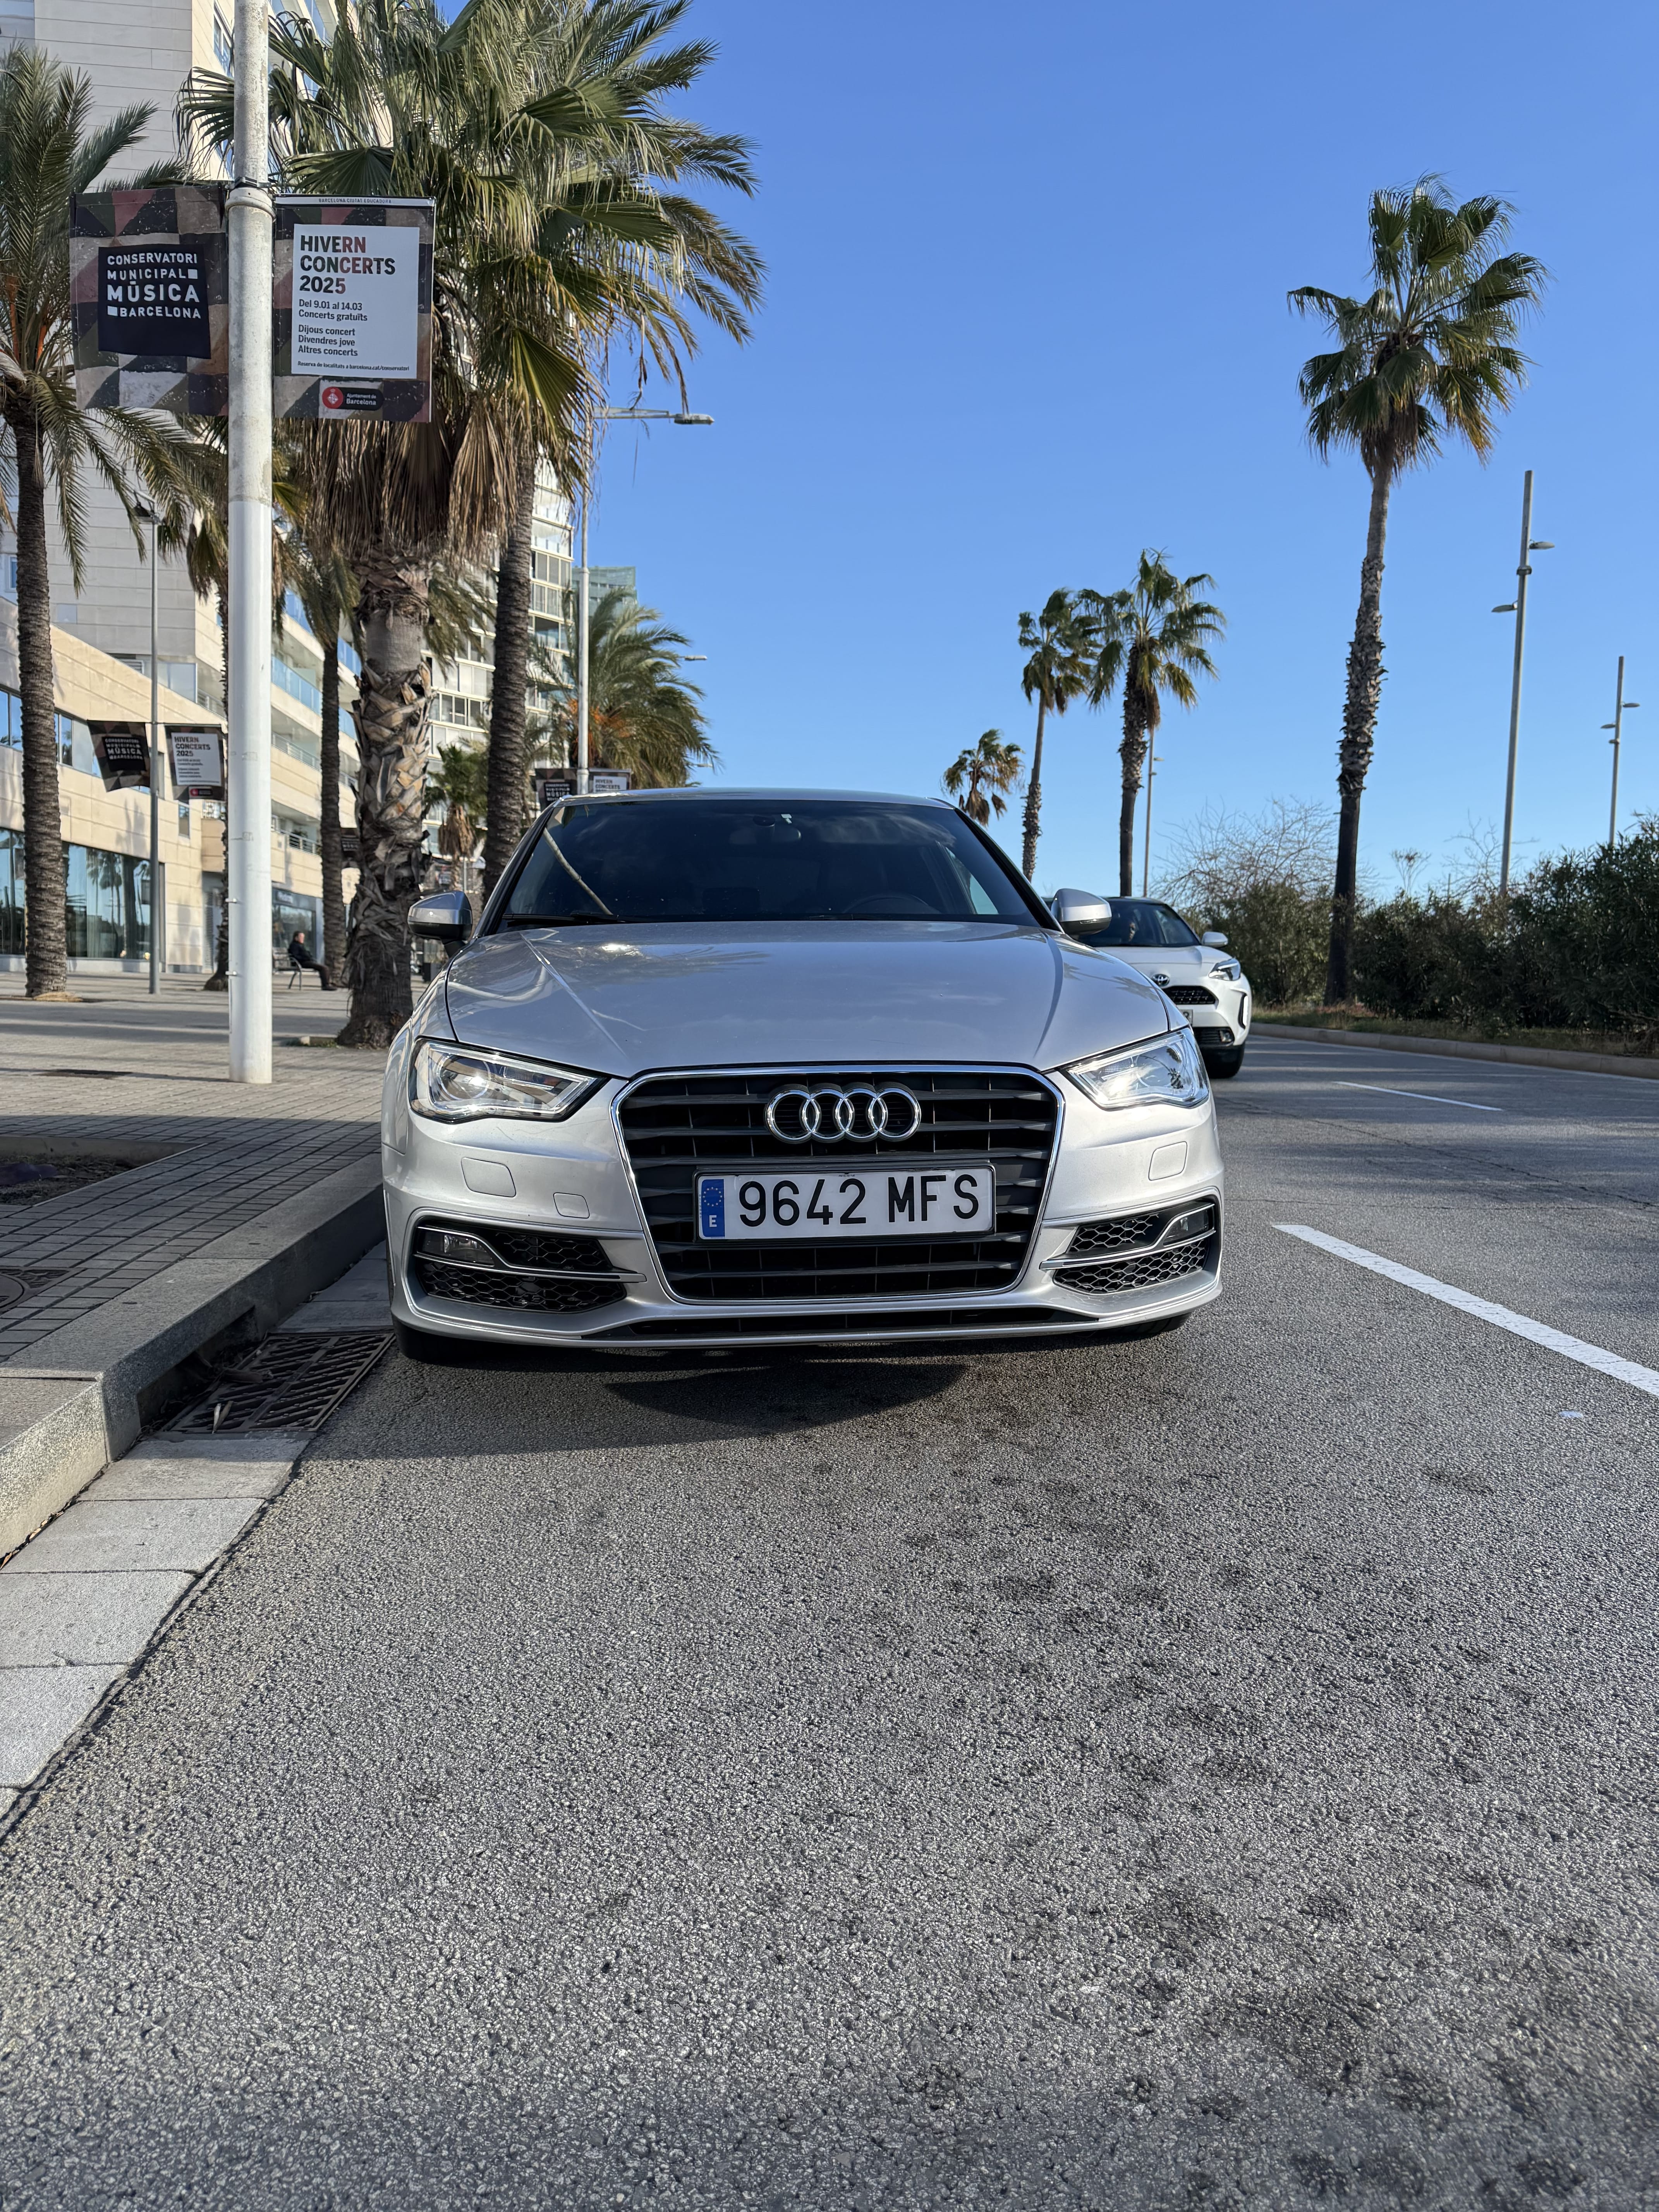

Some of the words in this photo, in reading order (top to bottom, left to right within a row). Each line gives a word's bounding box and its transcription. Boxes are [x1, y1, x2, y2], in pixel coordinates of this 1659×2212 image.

[301, 235, 366, 253] HIVERN
[107, 252, 197, 265] CONSERVATORI
[300, 255, 395, 275] CONCERTS
[107, 268, 186, 280] MUNICIPAL
[299, 275, 346, 294] 2025
[299, 299, 311, 307] Del
[314, 301, 330, 309] 9.01
[120, 306, 201, 319] BARCELONA
[299, 309, 335, 319] Concerts
[337, 313, 368, 321] gratuïts
[299, 325, 323, 334] Dijous
[298, 335, 337, 345] Divendres
[339, 338, 355, 347] jove
[298, 345, 322, 354] Altres
[739, 1178, 866, 1227] 9642
[888, 1174, 979, 1223] MFS
[709, 1215, 717, 1227] E
